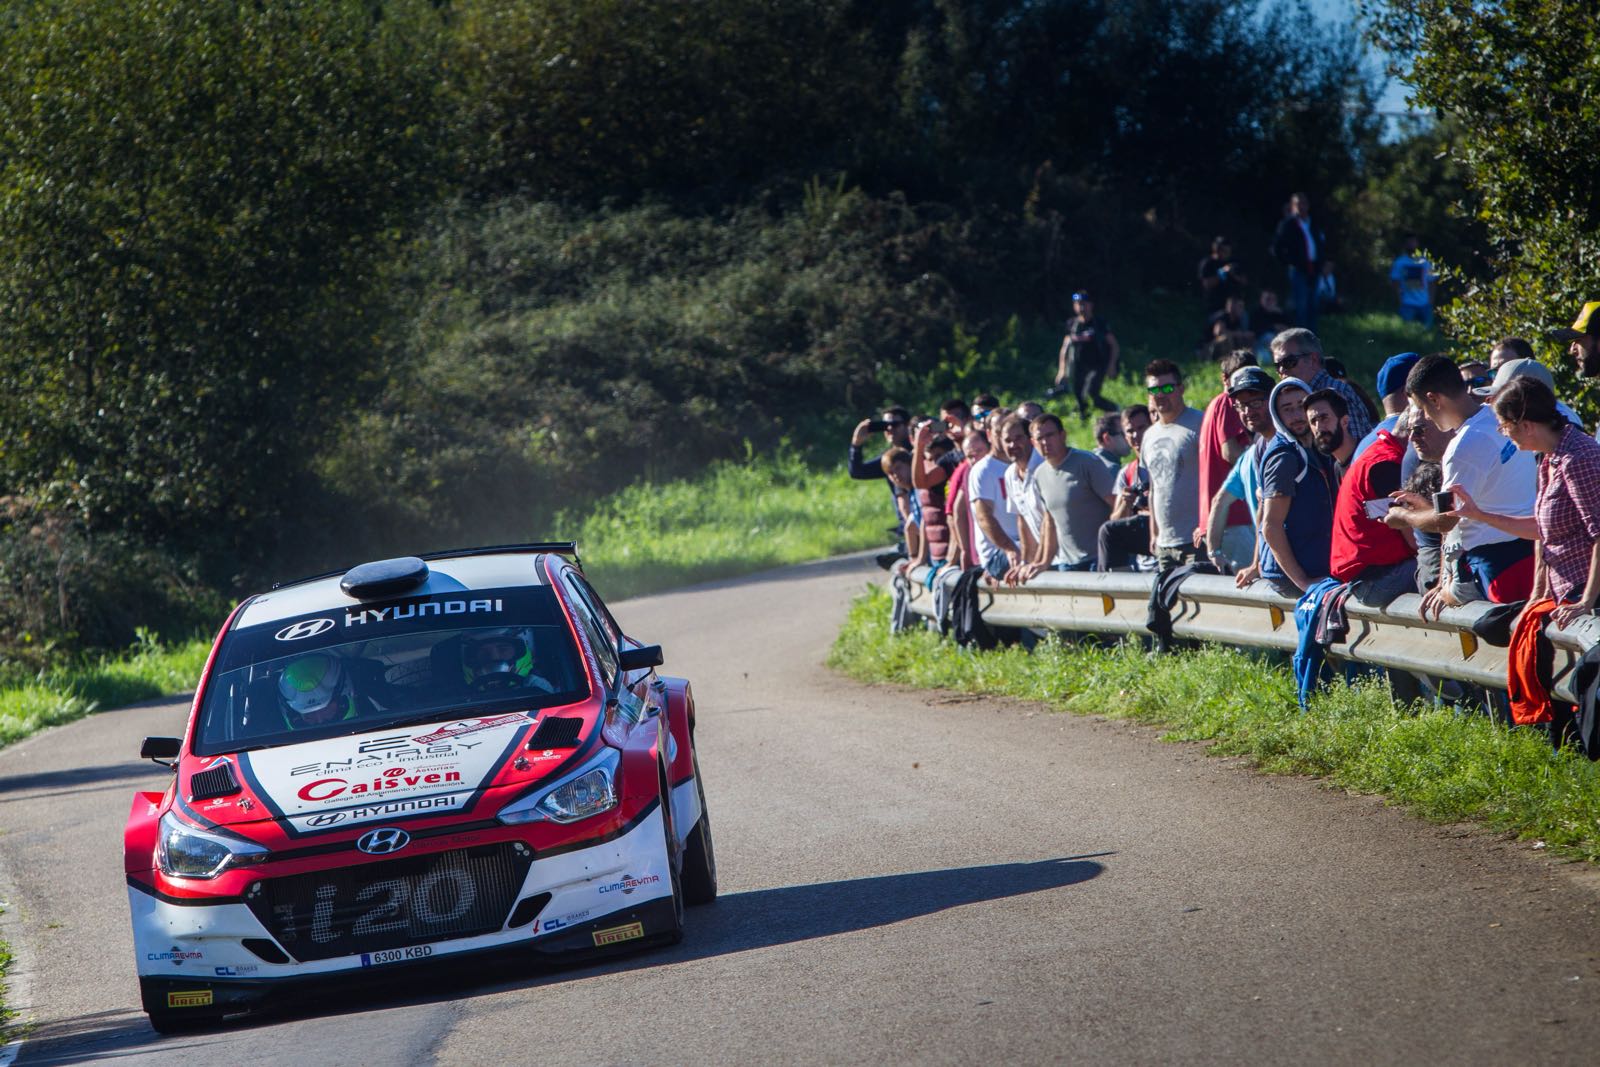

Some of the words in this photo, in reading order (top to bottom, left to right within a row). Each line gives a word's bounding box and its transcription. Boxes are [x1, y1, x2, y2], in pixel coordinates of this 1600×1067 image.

[345, 599, 503, 627] HYUNDAI
[357, 761, 383, 769] eco
[399, 751, 458, 762] industrial
[416, 765, 455, 773] Asturias
[353, 796, 455, 818] HYUNDAI
[543, 919, 567, 931] CL
[594, 924, 642, 945] PIRELLI
[374, 950, 402, 963] 6300
[405, 945, 432, 958] KBD
[214, 966, 237, 976] CL
[169, 992, 211, 1006] PIRELLI
